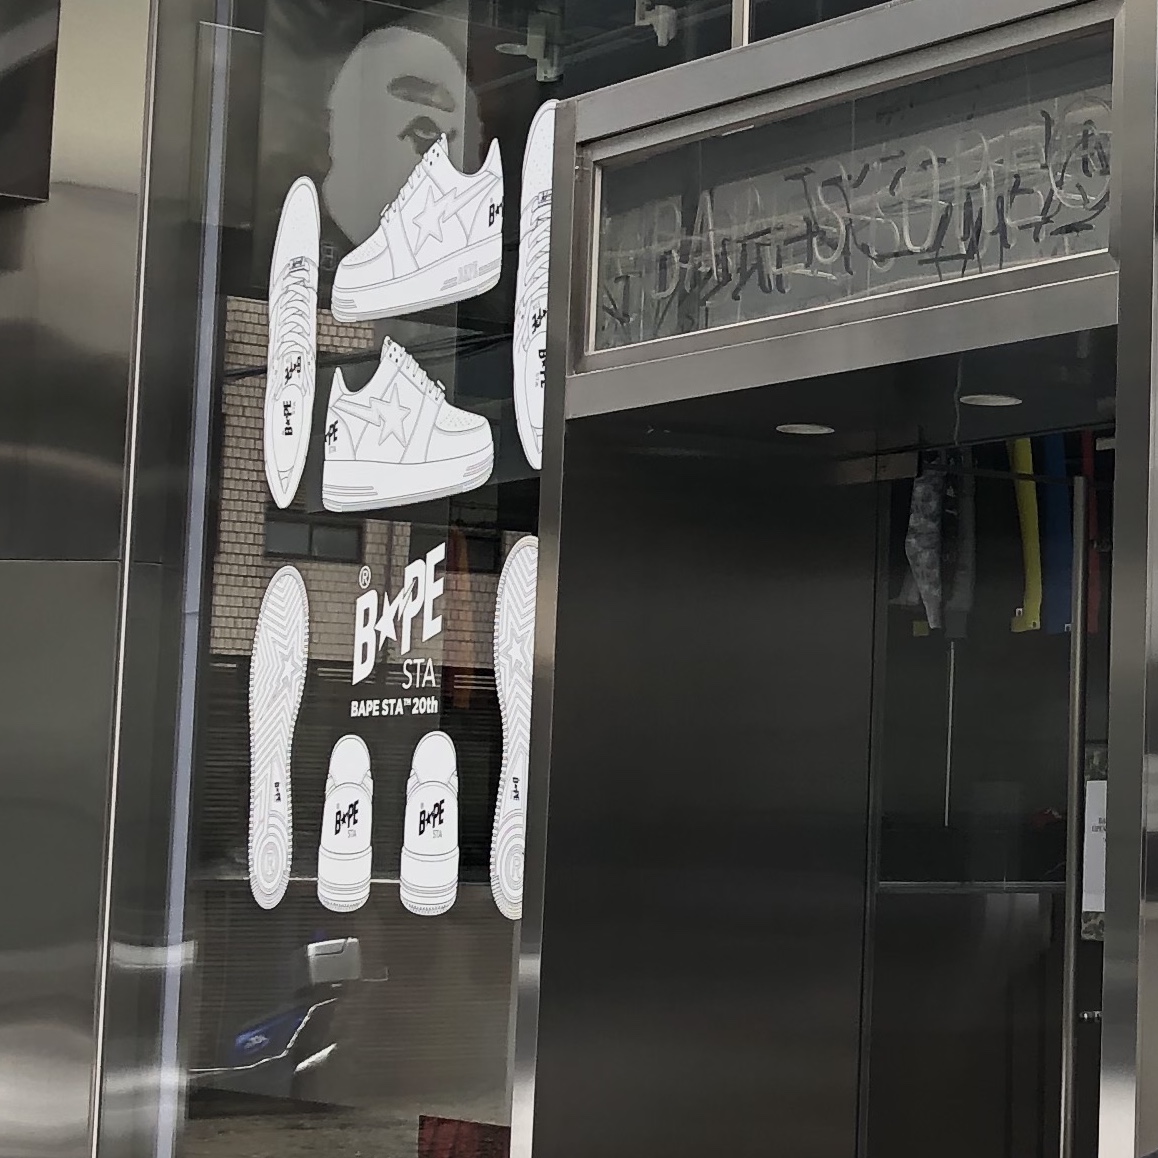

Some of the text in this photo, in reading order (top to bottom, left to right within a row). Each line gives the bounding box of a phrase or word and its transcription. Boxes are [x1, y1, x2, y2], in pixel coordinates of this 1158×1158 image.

[401, 657, 436, 690] STA
[351, 700, 381, 717] BAPE
[412, 696, 439, 715] 20th
